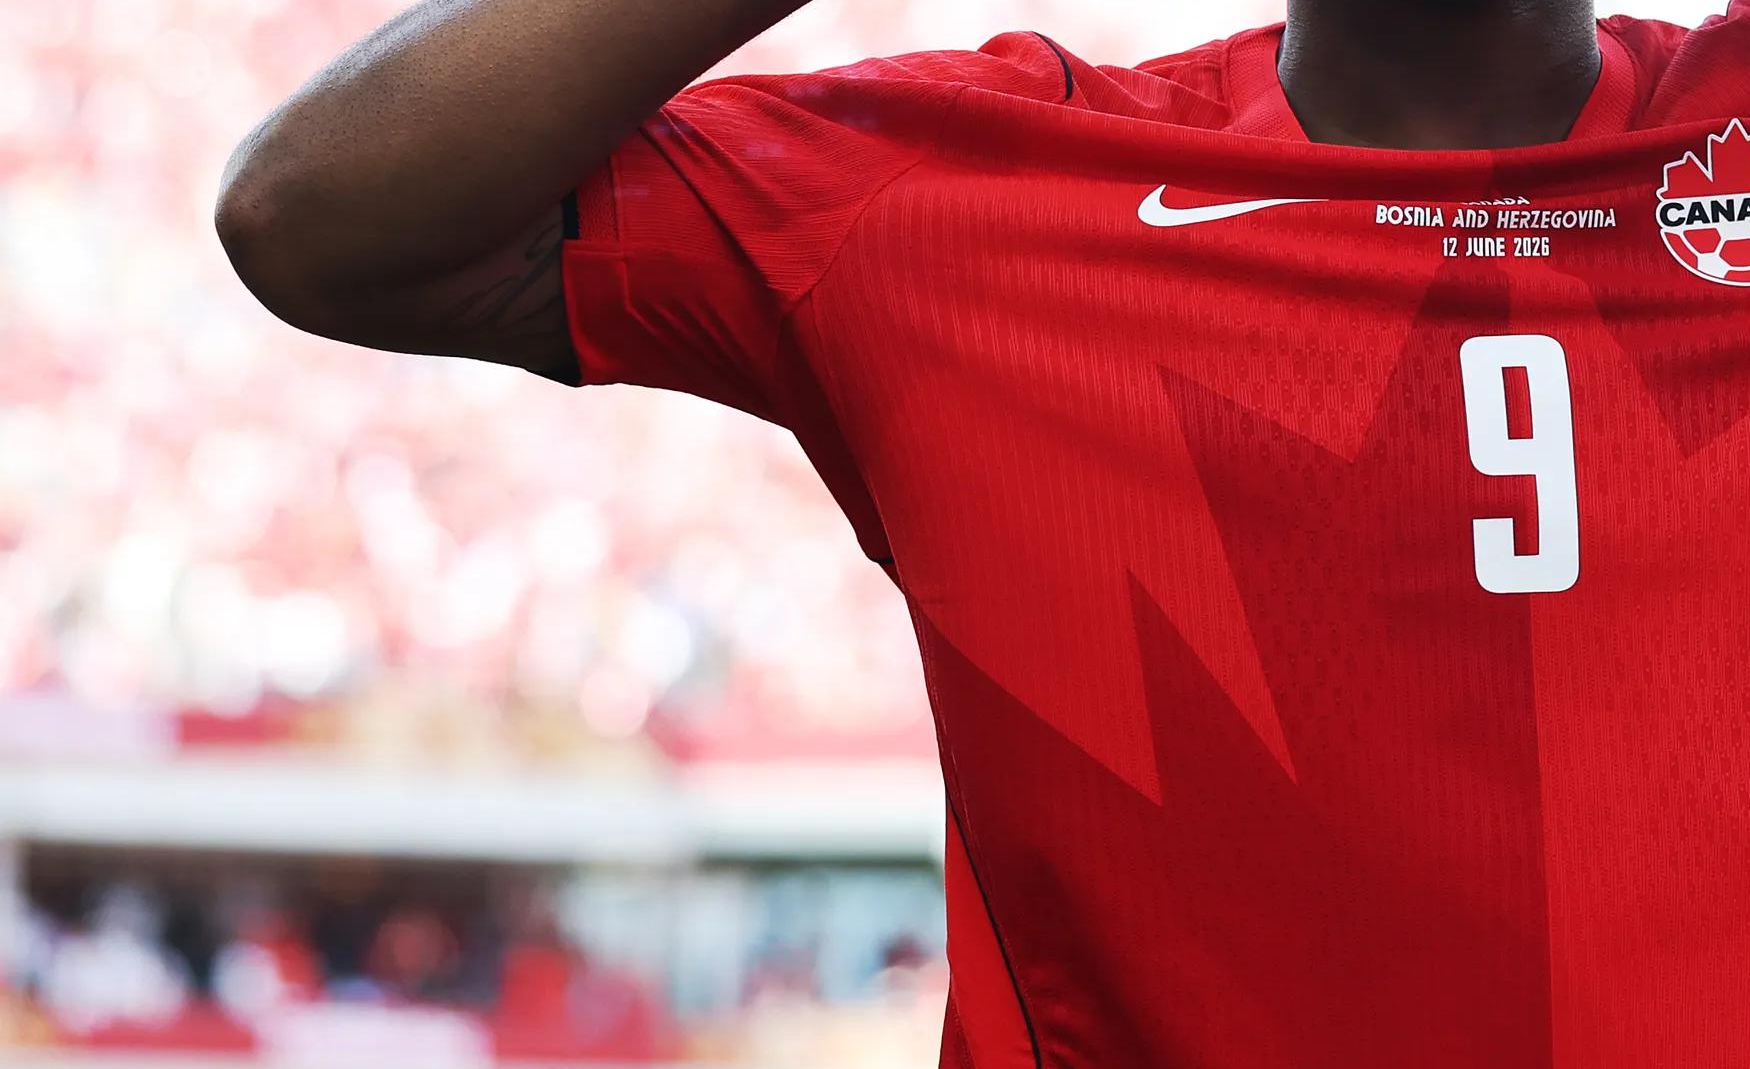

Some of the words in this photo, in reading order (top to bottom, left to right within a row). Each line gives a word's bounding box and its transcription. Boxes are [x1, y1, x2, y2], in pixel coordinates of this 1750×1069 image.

[1375, 204, 1444, 227] BOSNIA
[1452, 208, 1489, 228] AND
[1496, 208, 1616, 229] HERZEGOVINA
[1442, 237, 1458, 257] 12
[1465, 237, 1506, 257] JUNE
[1513, 236, 1550, 257] 2026
[1459, 334, 1580, 594] 9
